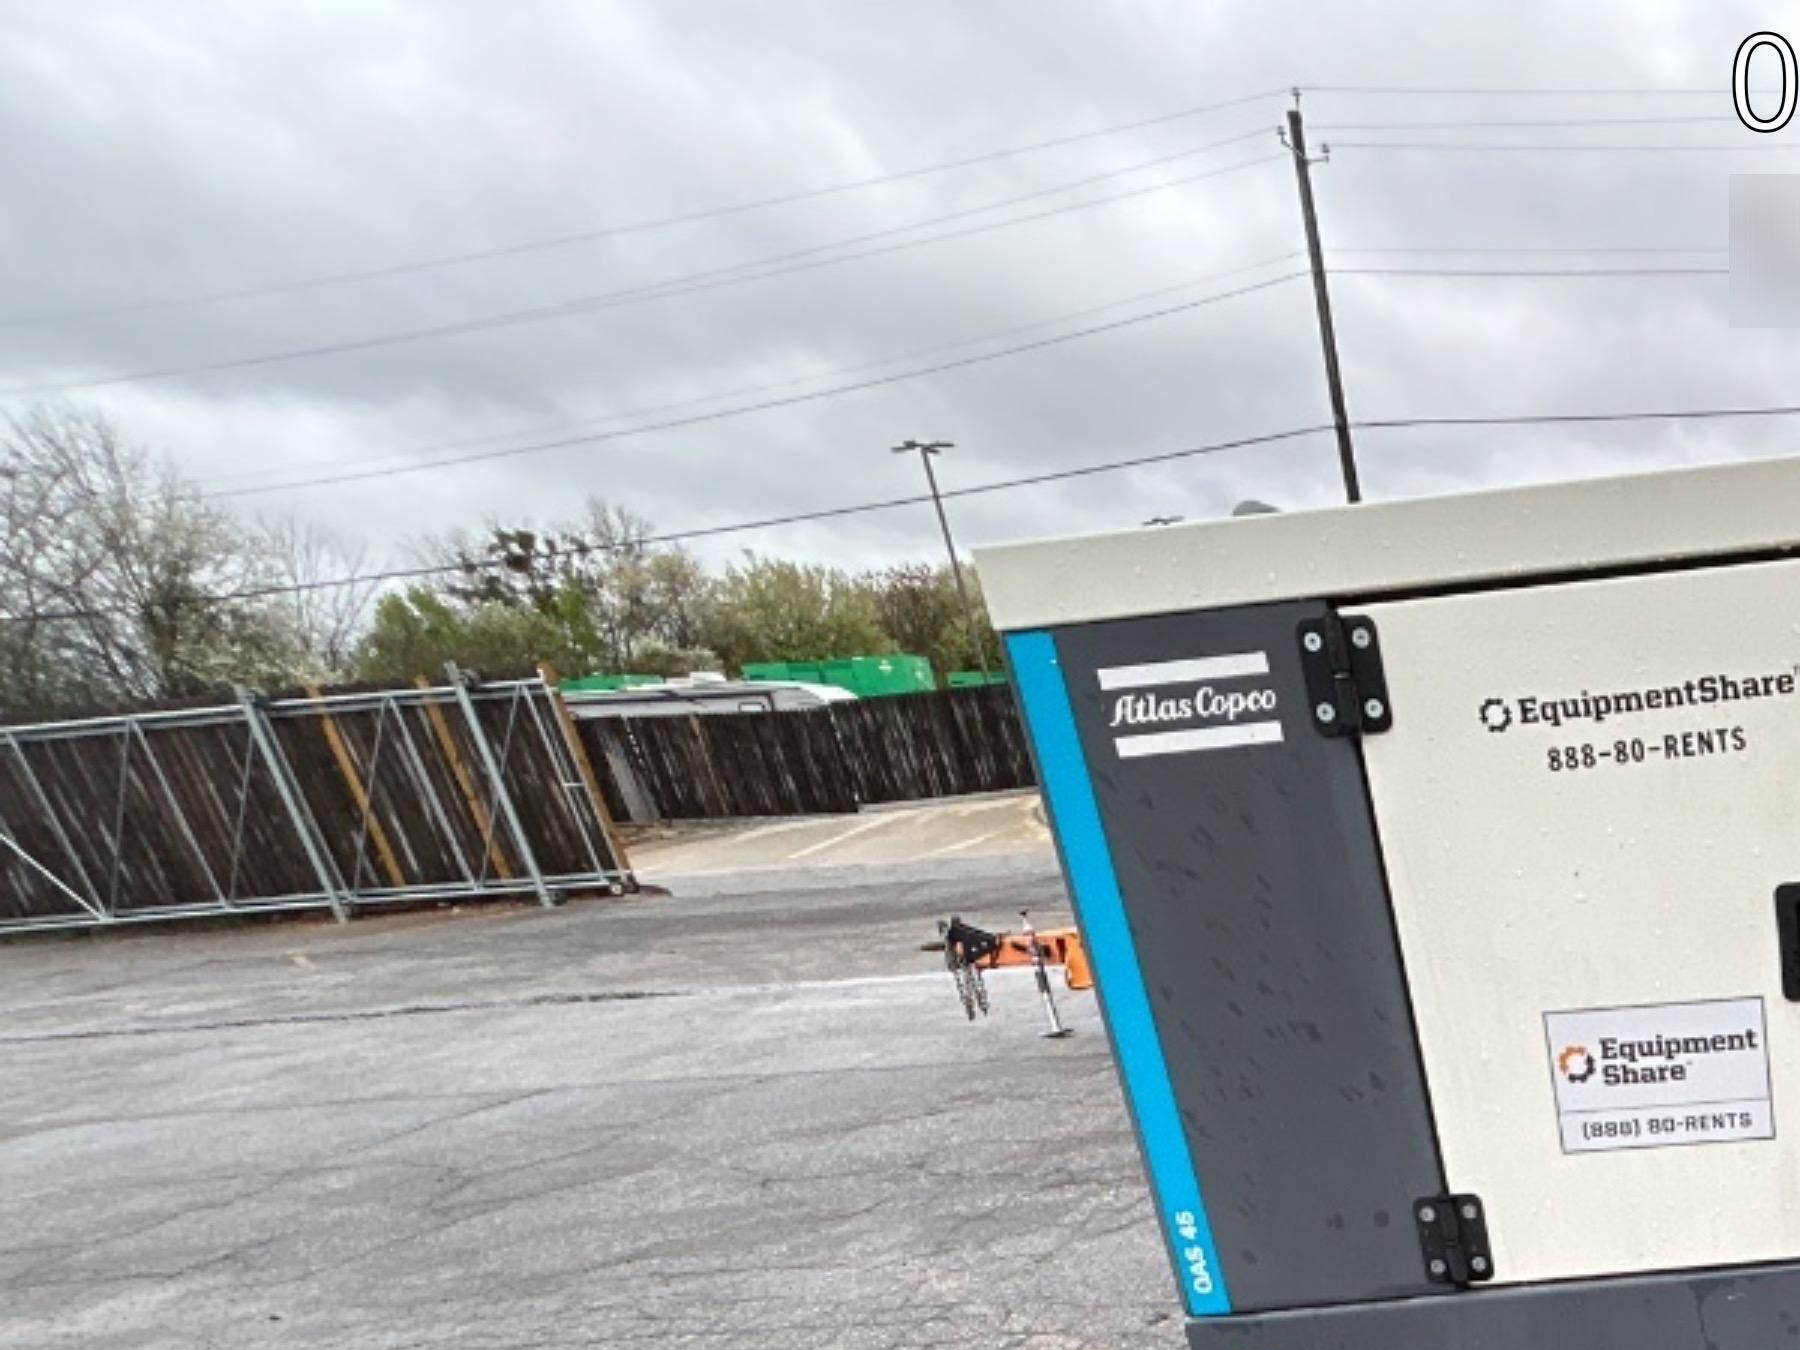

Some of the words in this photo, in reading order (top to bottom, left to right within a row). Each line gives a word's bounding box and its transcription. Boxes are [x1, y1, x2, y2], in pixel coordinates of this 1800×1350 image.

[1109, 691, 1193, 727] Atlas
[1194, 685, 1277, 721] Copco
[1547, 726, 1748, 772] 888-80-RENTS
[1599, 1027, 1759, 1063] Equipment
[1647, 1111, 1753, 1135] 80-RENTS
